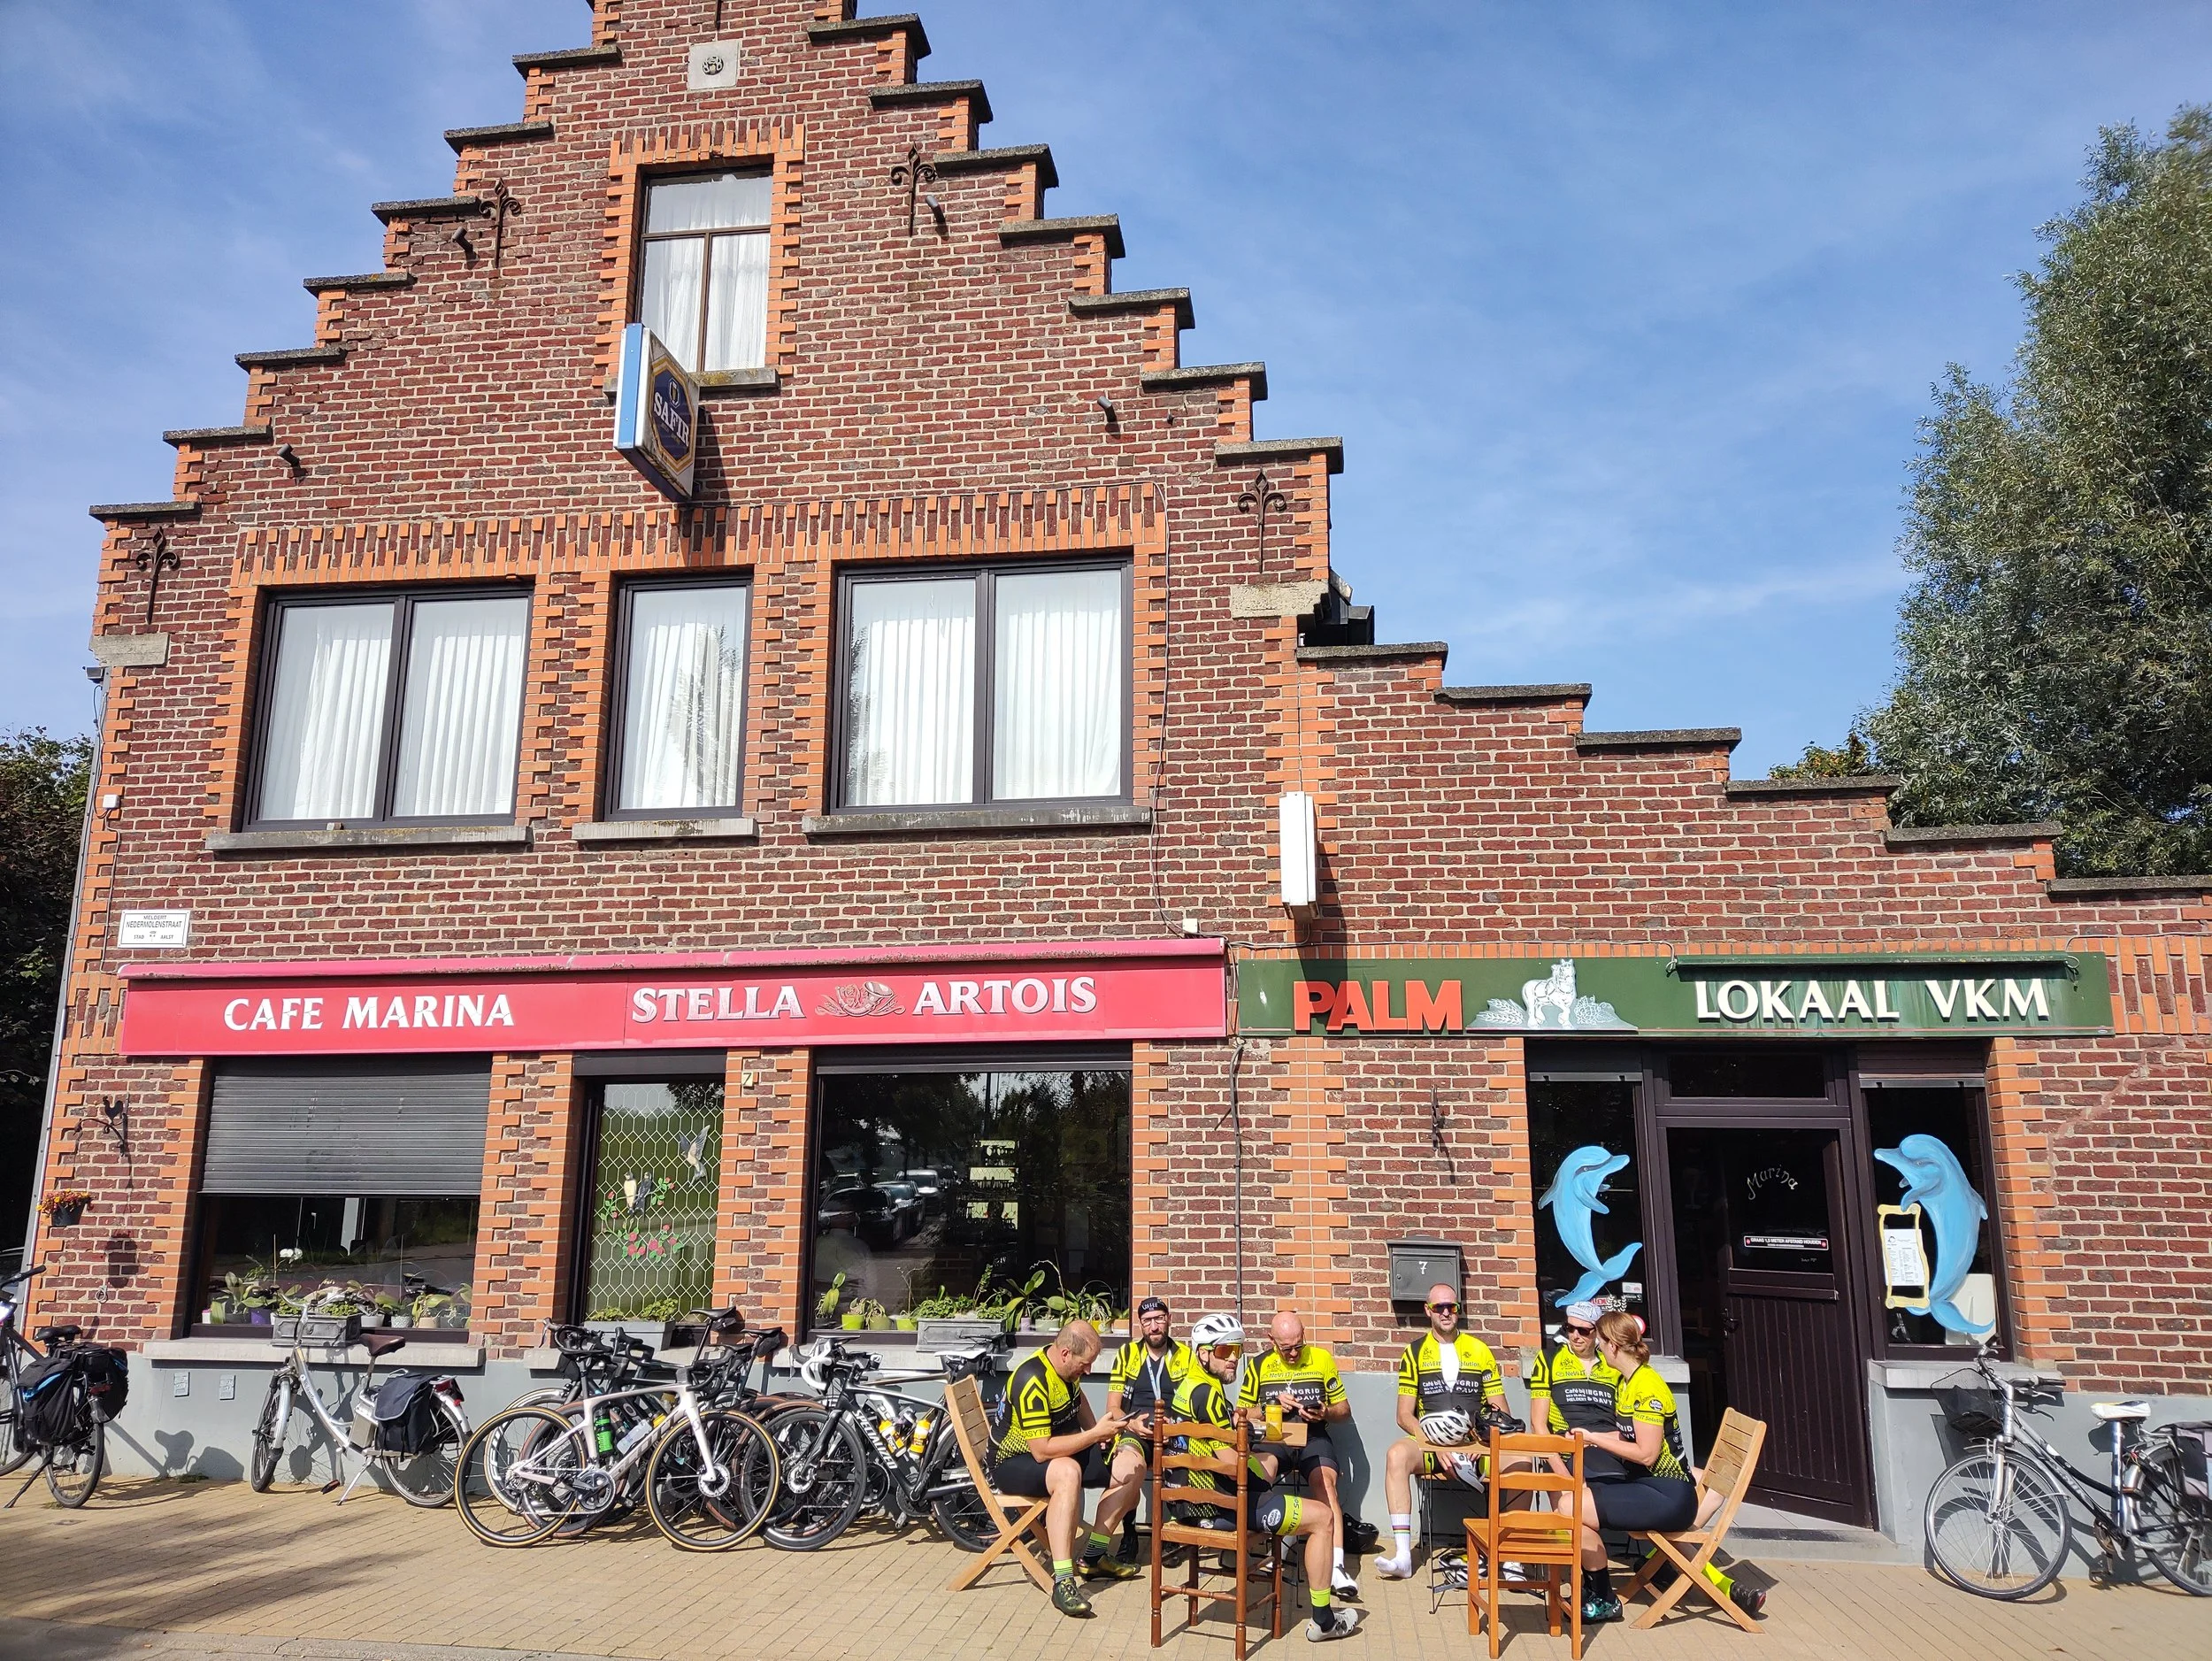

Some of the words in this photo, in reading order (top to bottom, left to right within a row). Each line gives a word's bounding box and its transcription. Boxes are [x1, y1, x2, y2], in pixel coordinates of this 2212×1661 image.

[653, 391, 689, 447] SAFIR
[223, 996, 325, 1032] CAFE
[342, 993, 515, 1030] MARINA
[631, 984, 807, 1024] STELLA
[911, 975, 1097, 1016] ARTOIS
[1293, 980, 1463, 1034] PALM
[1694, 979, 1901, 1022] LOKAAL
[1924, 978, 2051, 1021] VKM
[742, 1072, 752, 1086] 7
[1747, 1164, 1800, 1200] Marina
[1418, 1260, 1428, 1275] 7
[852, 1410, 898, 1469] SPECIALIZED
